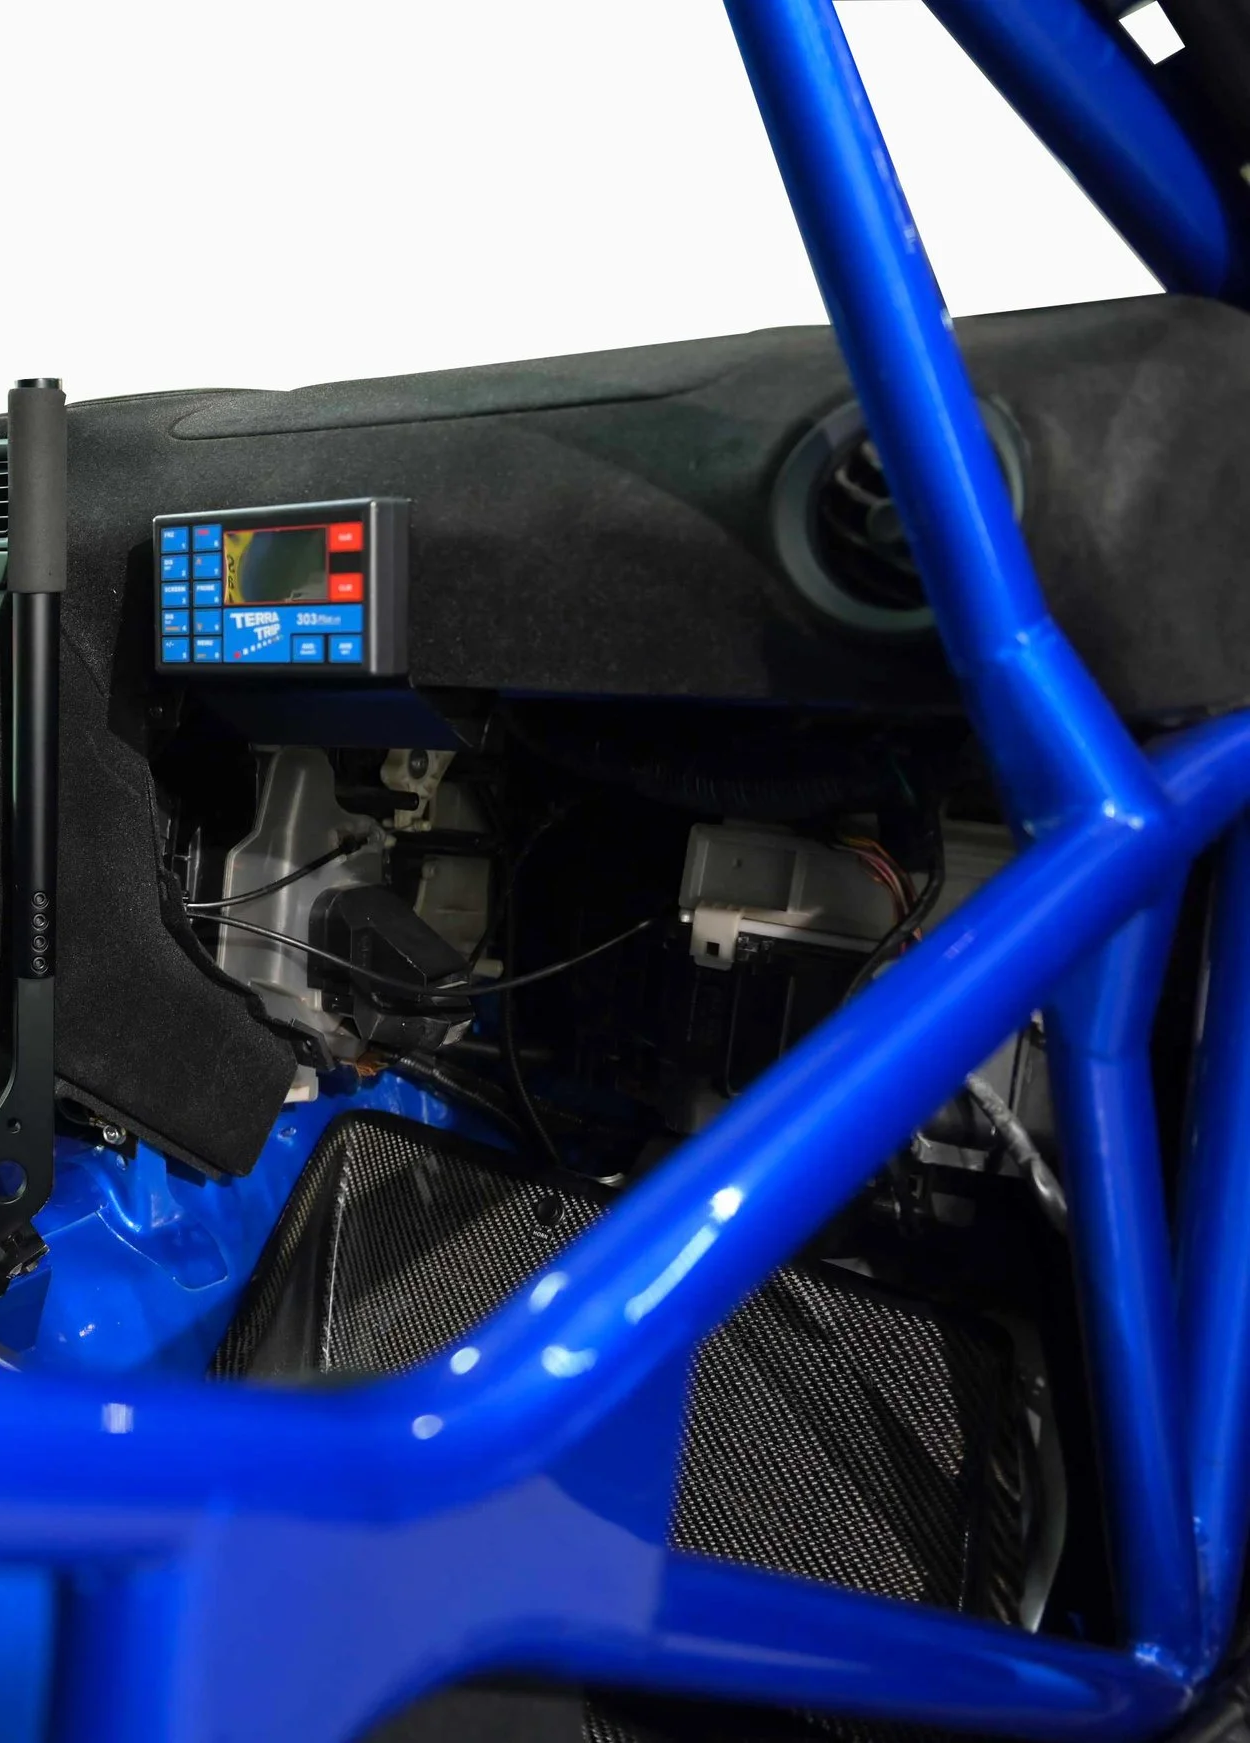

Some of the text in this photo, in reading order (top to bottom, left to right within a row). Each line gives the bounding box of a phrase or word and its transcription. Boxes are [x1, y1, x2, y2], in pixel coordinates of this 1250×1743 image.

[230, 611, 280, 629] TERRA
[296, 612, 318, 626] 303
[253, 623, 281, 641] TRIP
